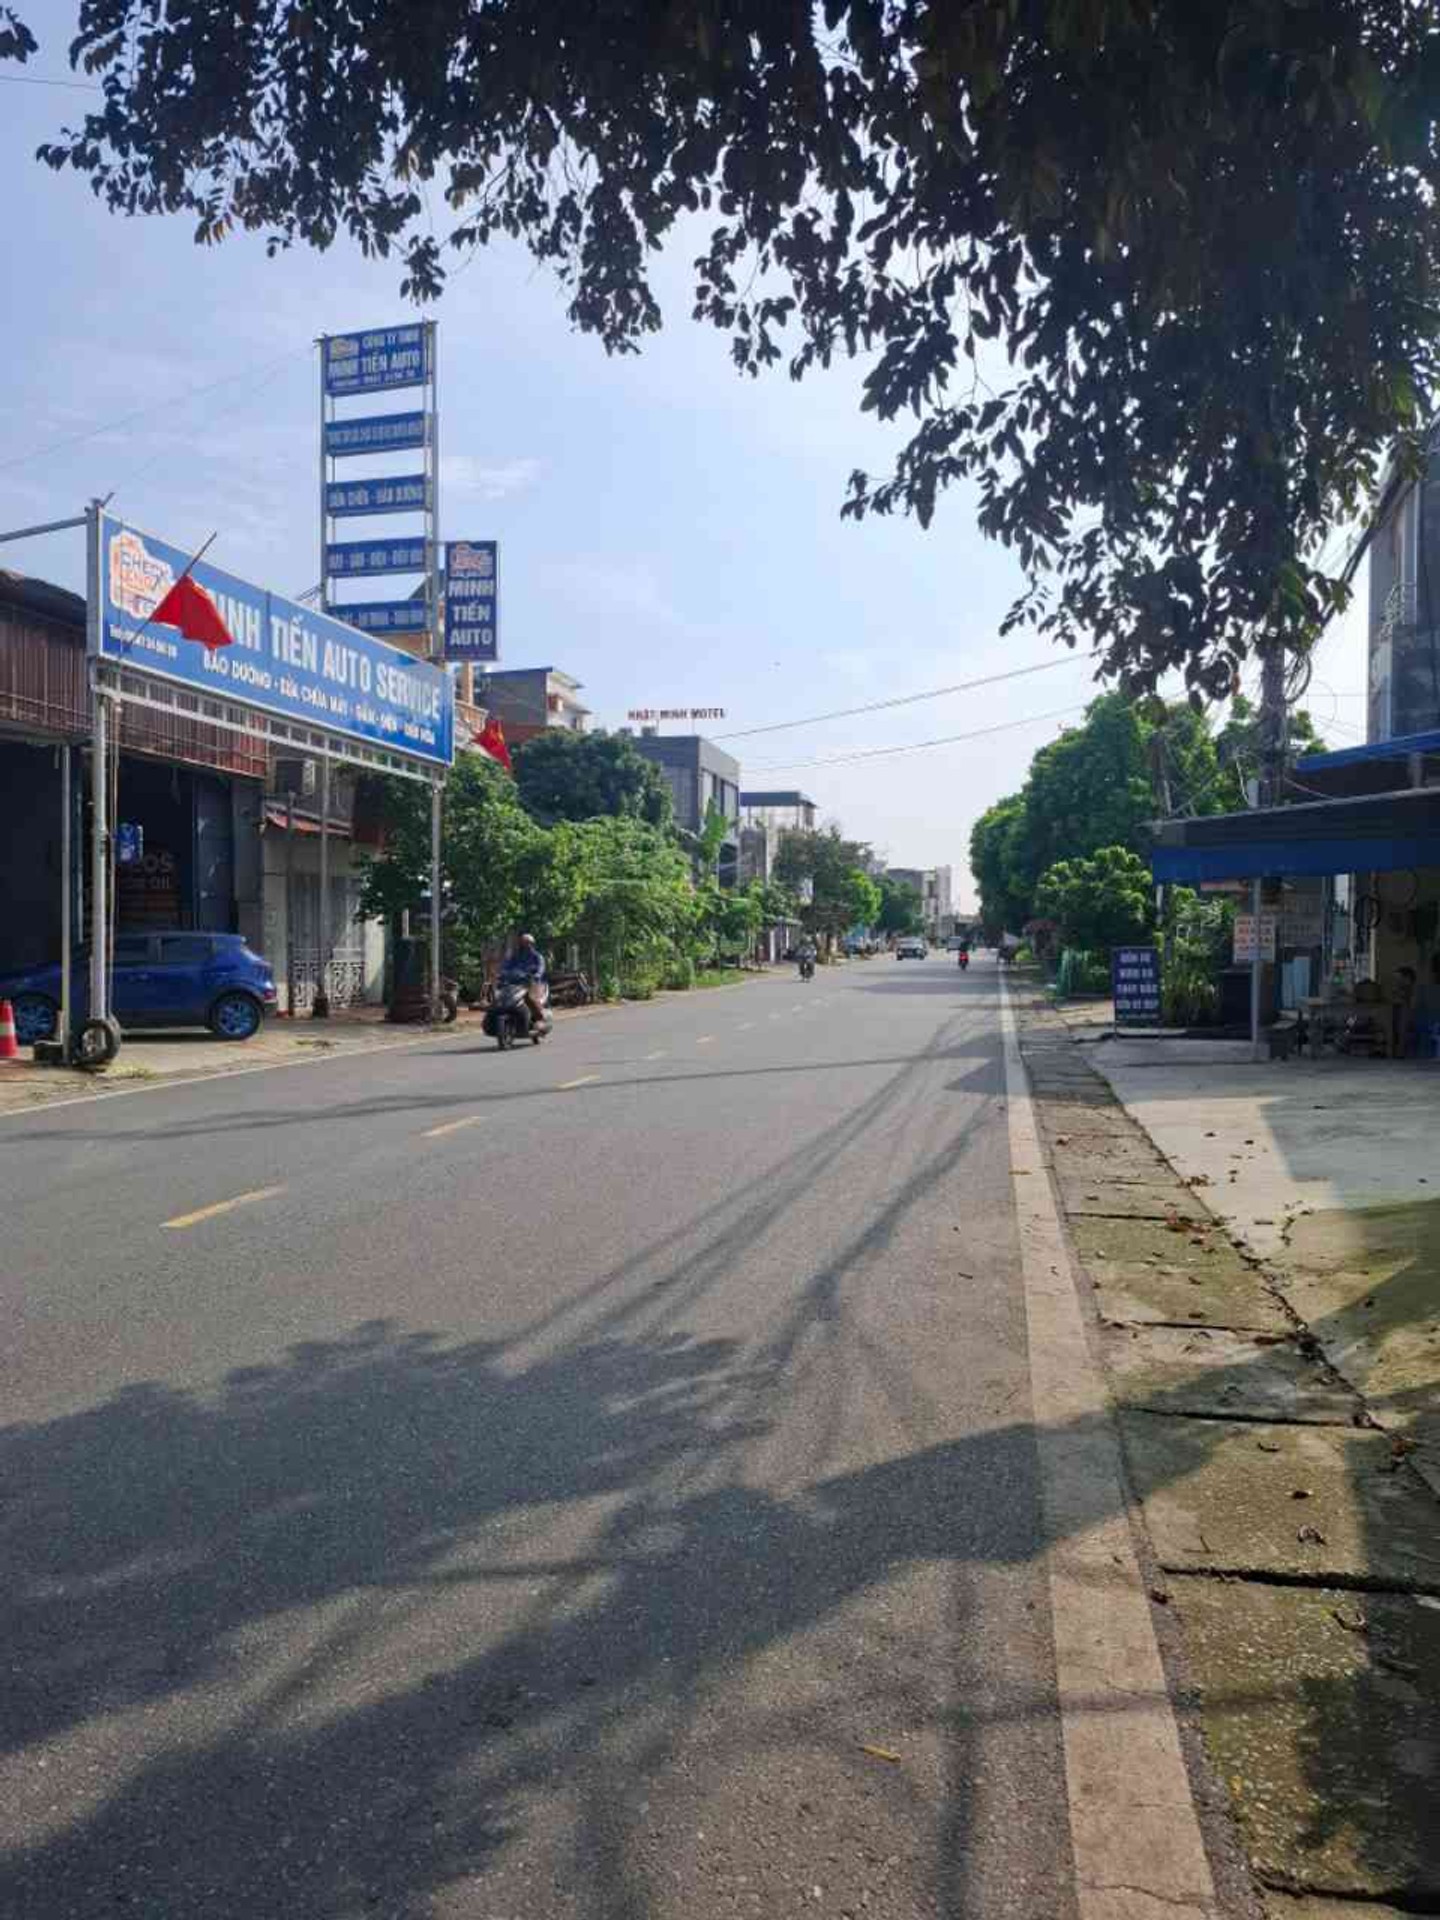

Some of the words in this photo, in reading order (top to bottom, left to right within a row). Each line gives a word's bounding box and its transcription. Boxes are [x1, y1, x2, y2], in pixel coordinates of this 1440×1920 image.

[448, 579, 494, 597] MINH
[453, 600, 491, 622] TIẾN
[450, 627, 493, 646] AUTO
[211, 588, 261, 652] INH
[269, 613, 317, 673] TIẾN
[323, 638, 371, 693] AUTO
[376, 660, 440, 720] SERVICE
